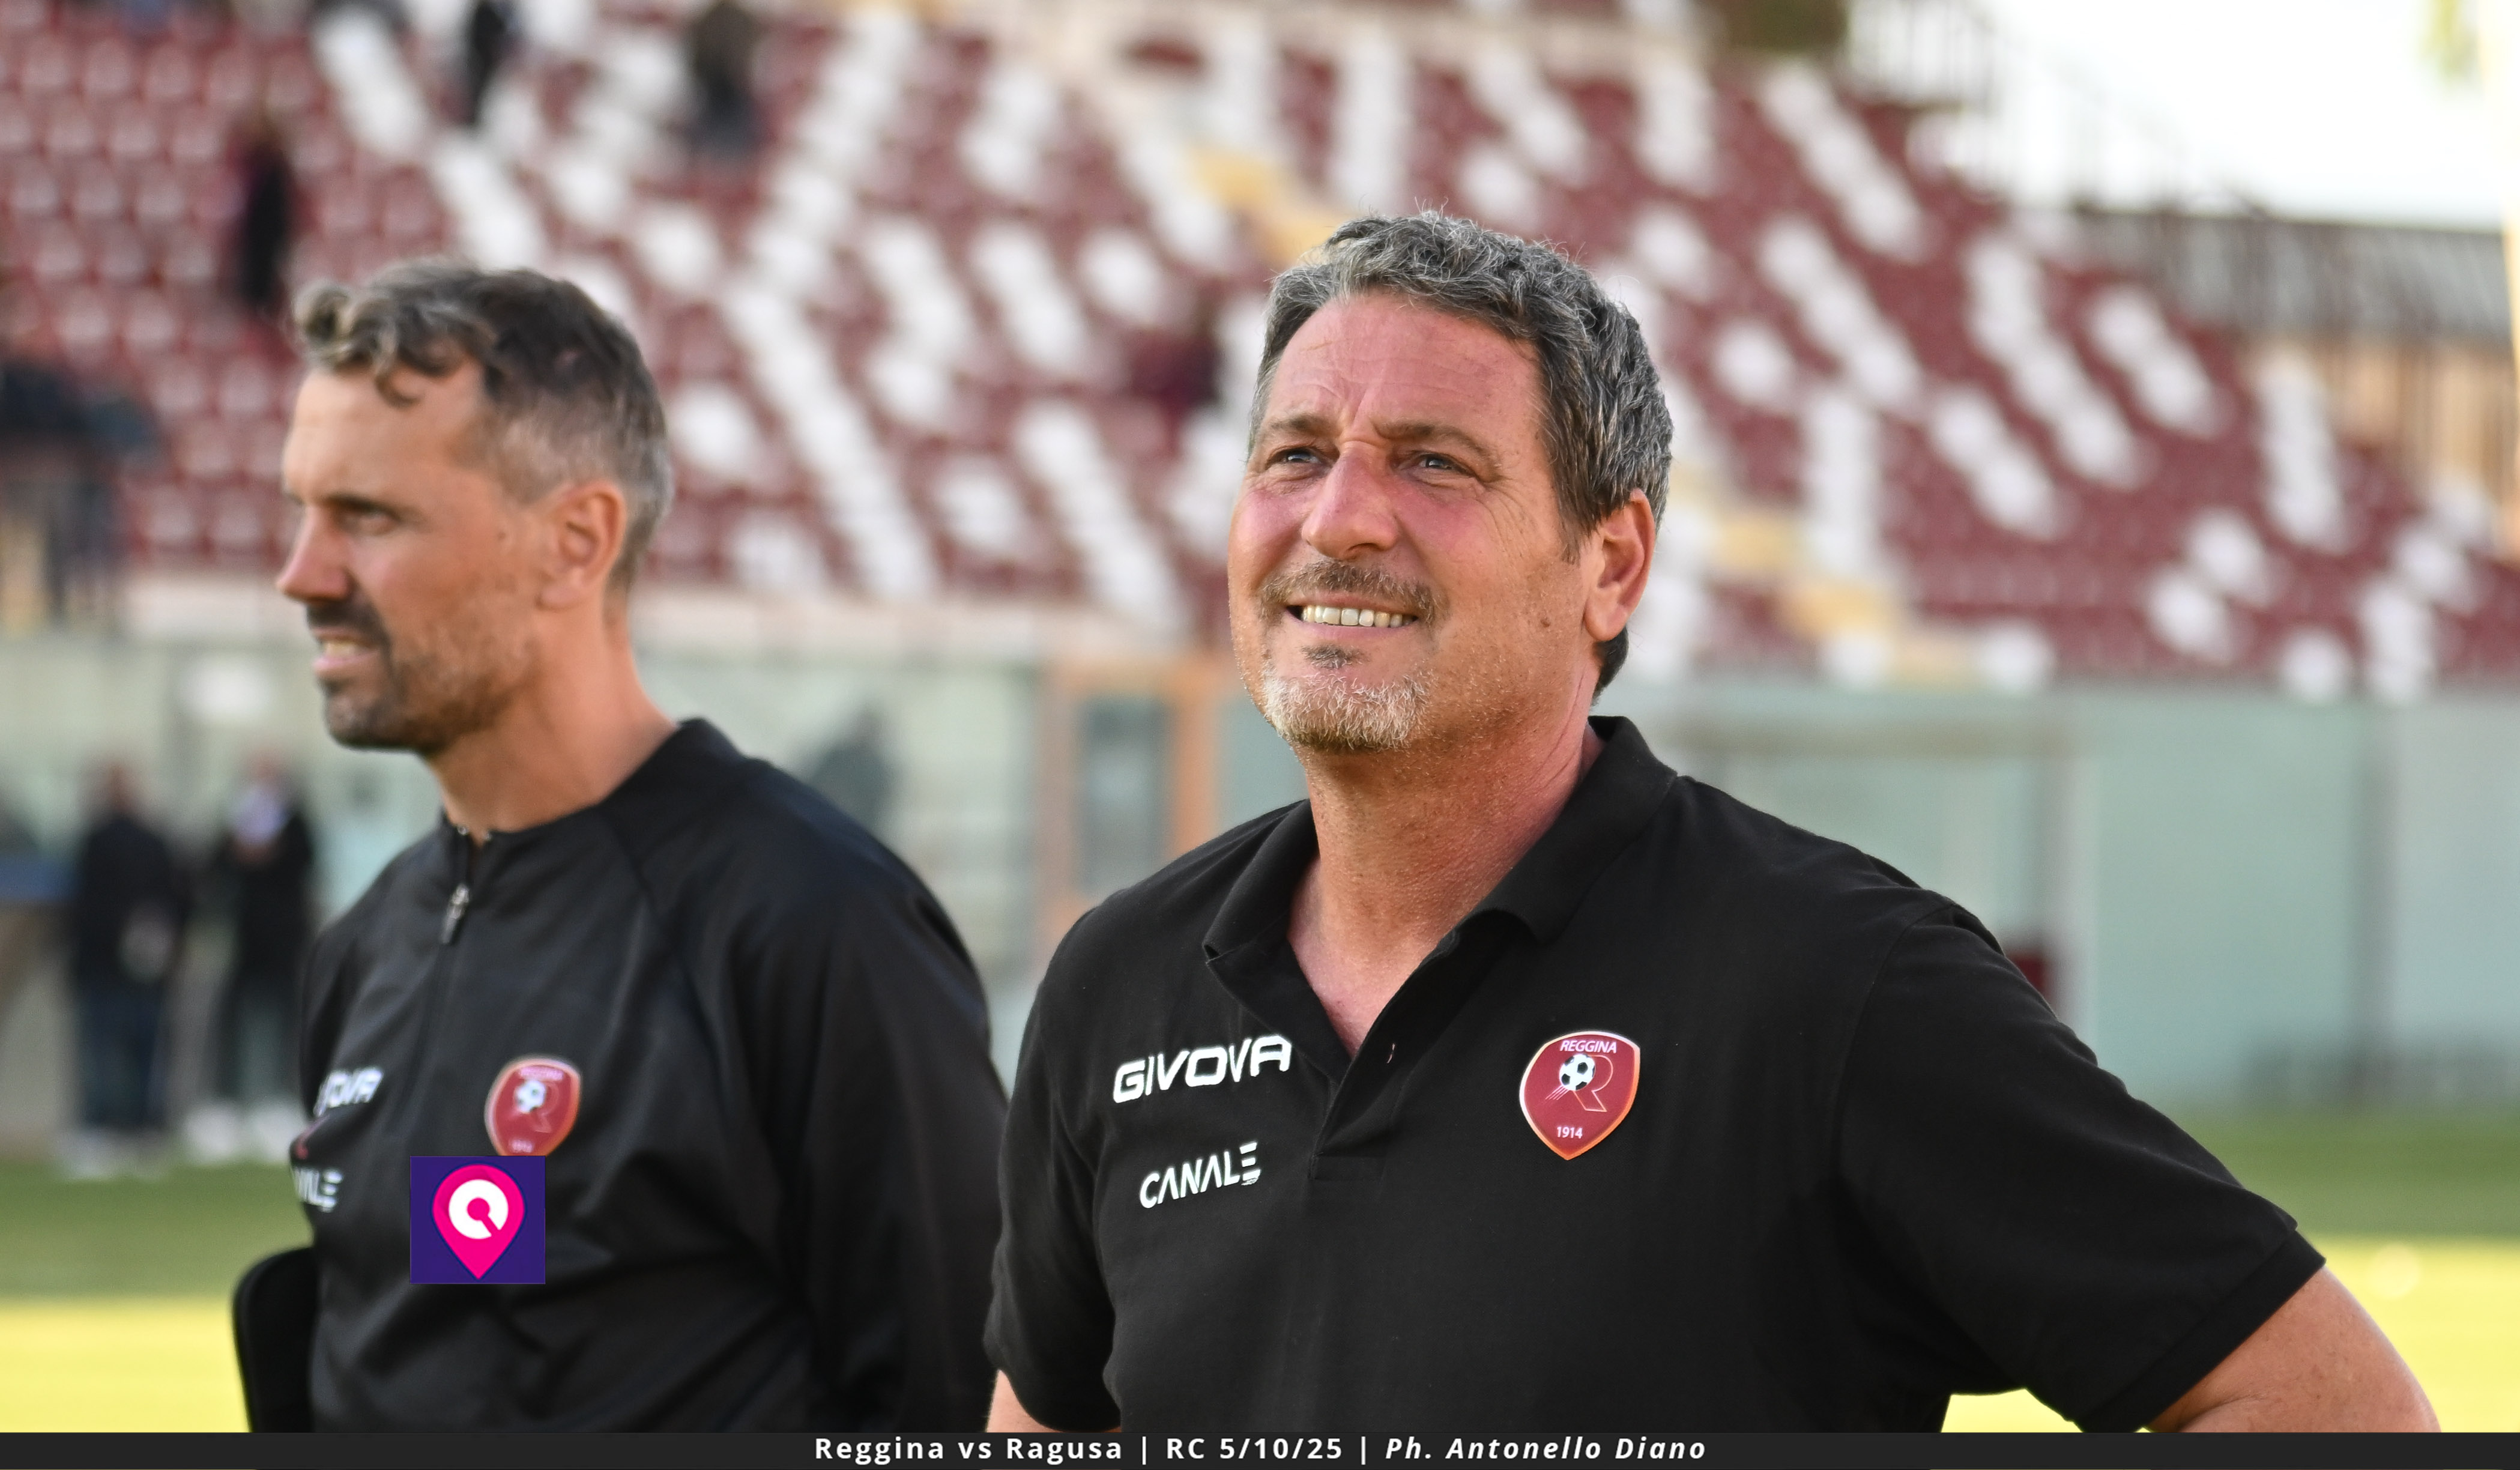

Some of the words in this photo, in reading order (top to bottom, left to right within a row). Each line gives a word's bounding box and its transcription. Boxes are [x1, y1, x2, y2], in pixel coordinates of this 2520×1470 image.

[1559, 1039, 1618, 1054] REGGINA
[1113, 1034, 1292, 1104] GIVOVA
[1556, 1126, 1583, 1139] 1914
[1140, 1141, 1261, 1209] CANALE
